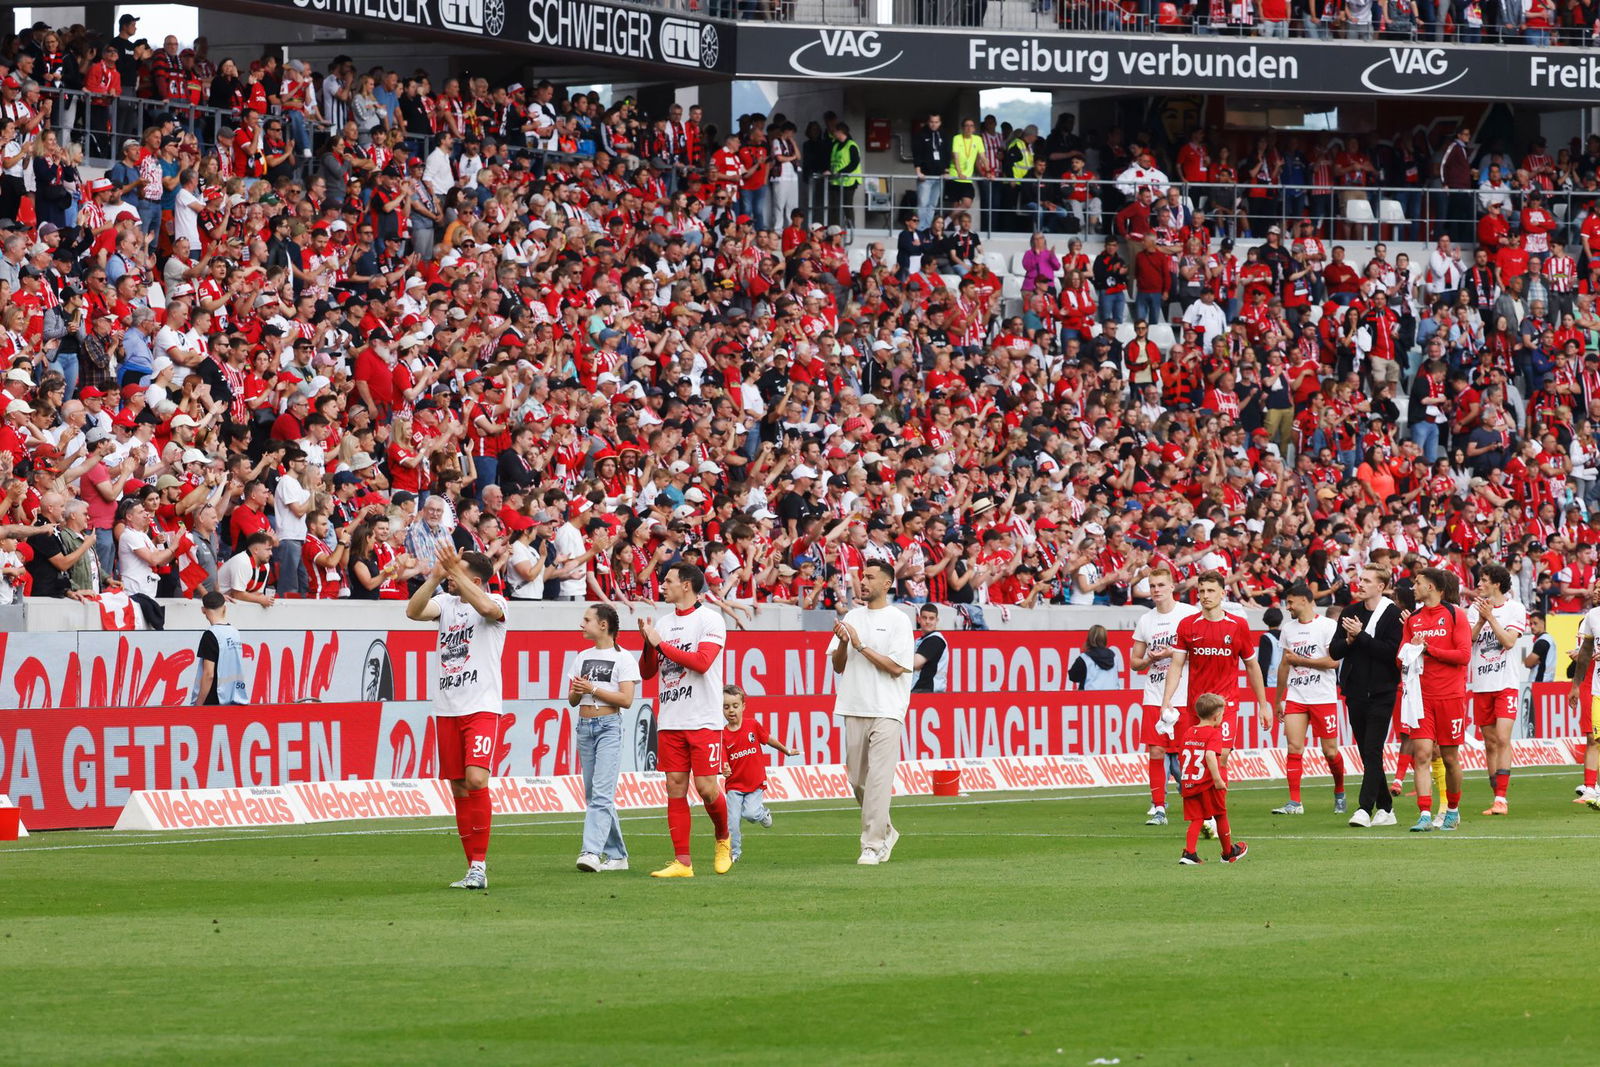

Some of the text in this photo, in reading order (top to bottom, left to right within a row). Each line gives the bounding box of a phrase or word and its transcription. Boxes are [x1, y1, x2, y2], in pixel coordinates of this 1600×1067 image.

[528, 0, 653, 59] SCHWEIGER
[819, 30, 882, 58] VAG
[968, 38, 1299, 82] Freiburg verbunden
[1389, 47, 1448, 75] VAG
[1192, 647, 1232, 657] JOBRAD
[235, 681, 246, 690] 50
[953, 705, 1049, 758] NACH
[1221, 721, 1230, 737] 8
[1324, 714, 1337, 729] 32
[1451, 718, 1463, 735] 37
[472, 735, 492, 756] 30
[708, 743, 720, 762] 27
[729, 747, 757, 761] JOBRAD
[992, 757, 1095, 787] WeberHaus
[1180, 748, 1206, 781] 23
[143, 789, 295, 828] WeberHaus
[294, 781, 432, 820] WeberHaus
